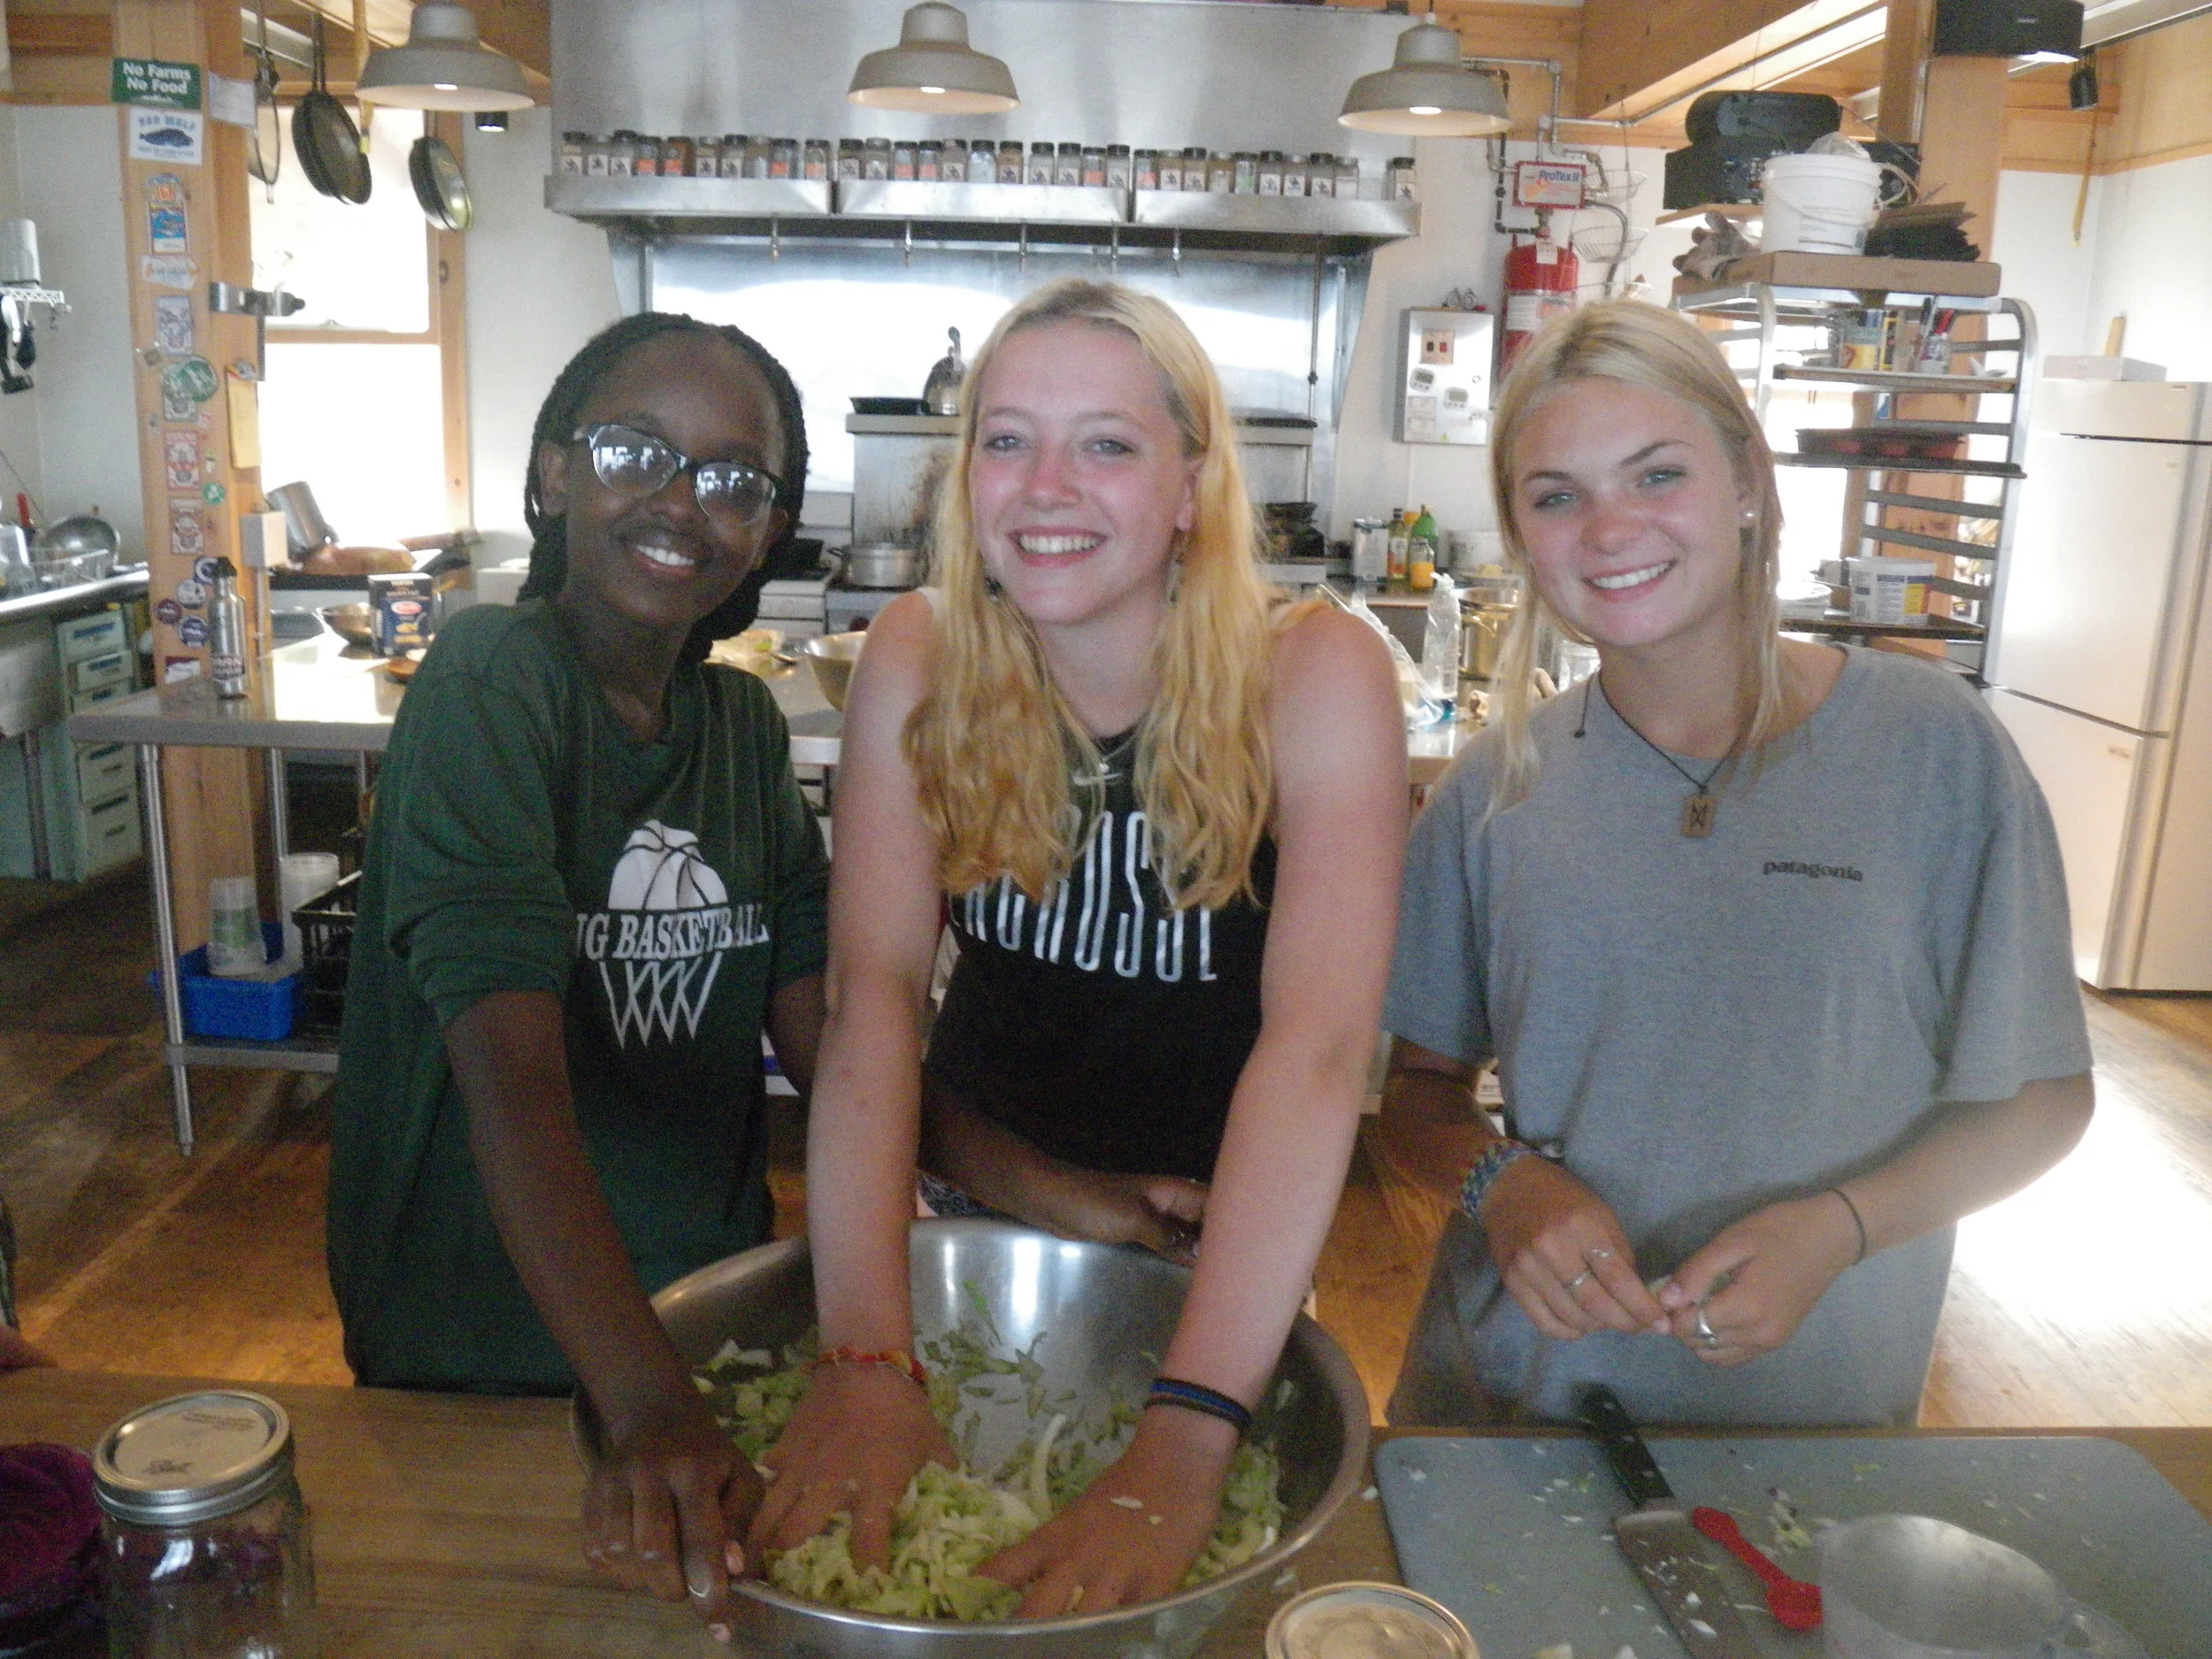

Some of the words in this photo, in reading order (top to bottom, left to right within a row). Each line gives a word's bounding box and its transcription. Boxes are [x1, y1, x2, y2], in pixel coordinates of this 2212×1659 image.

[123, 61, 144, 78] No
[147, 63, 191, 81] Farms
[127, 76, 148, 92] No
[151, 78, 188, 95] Food
[1763, 861, 1863, 882] patagonia
[948, 803, 1217, 982] CROSS
